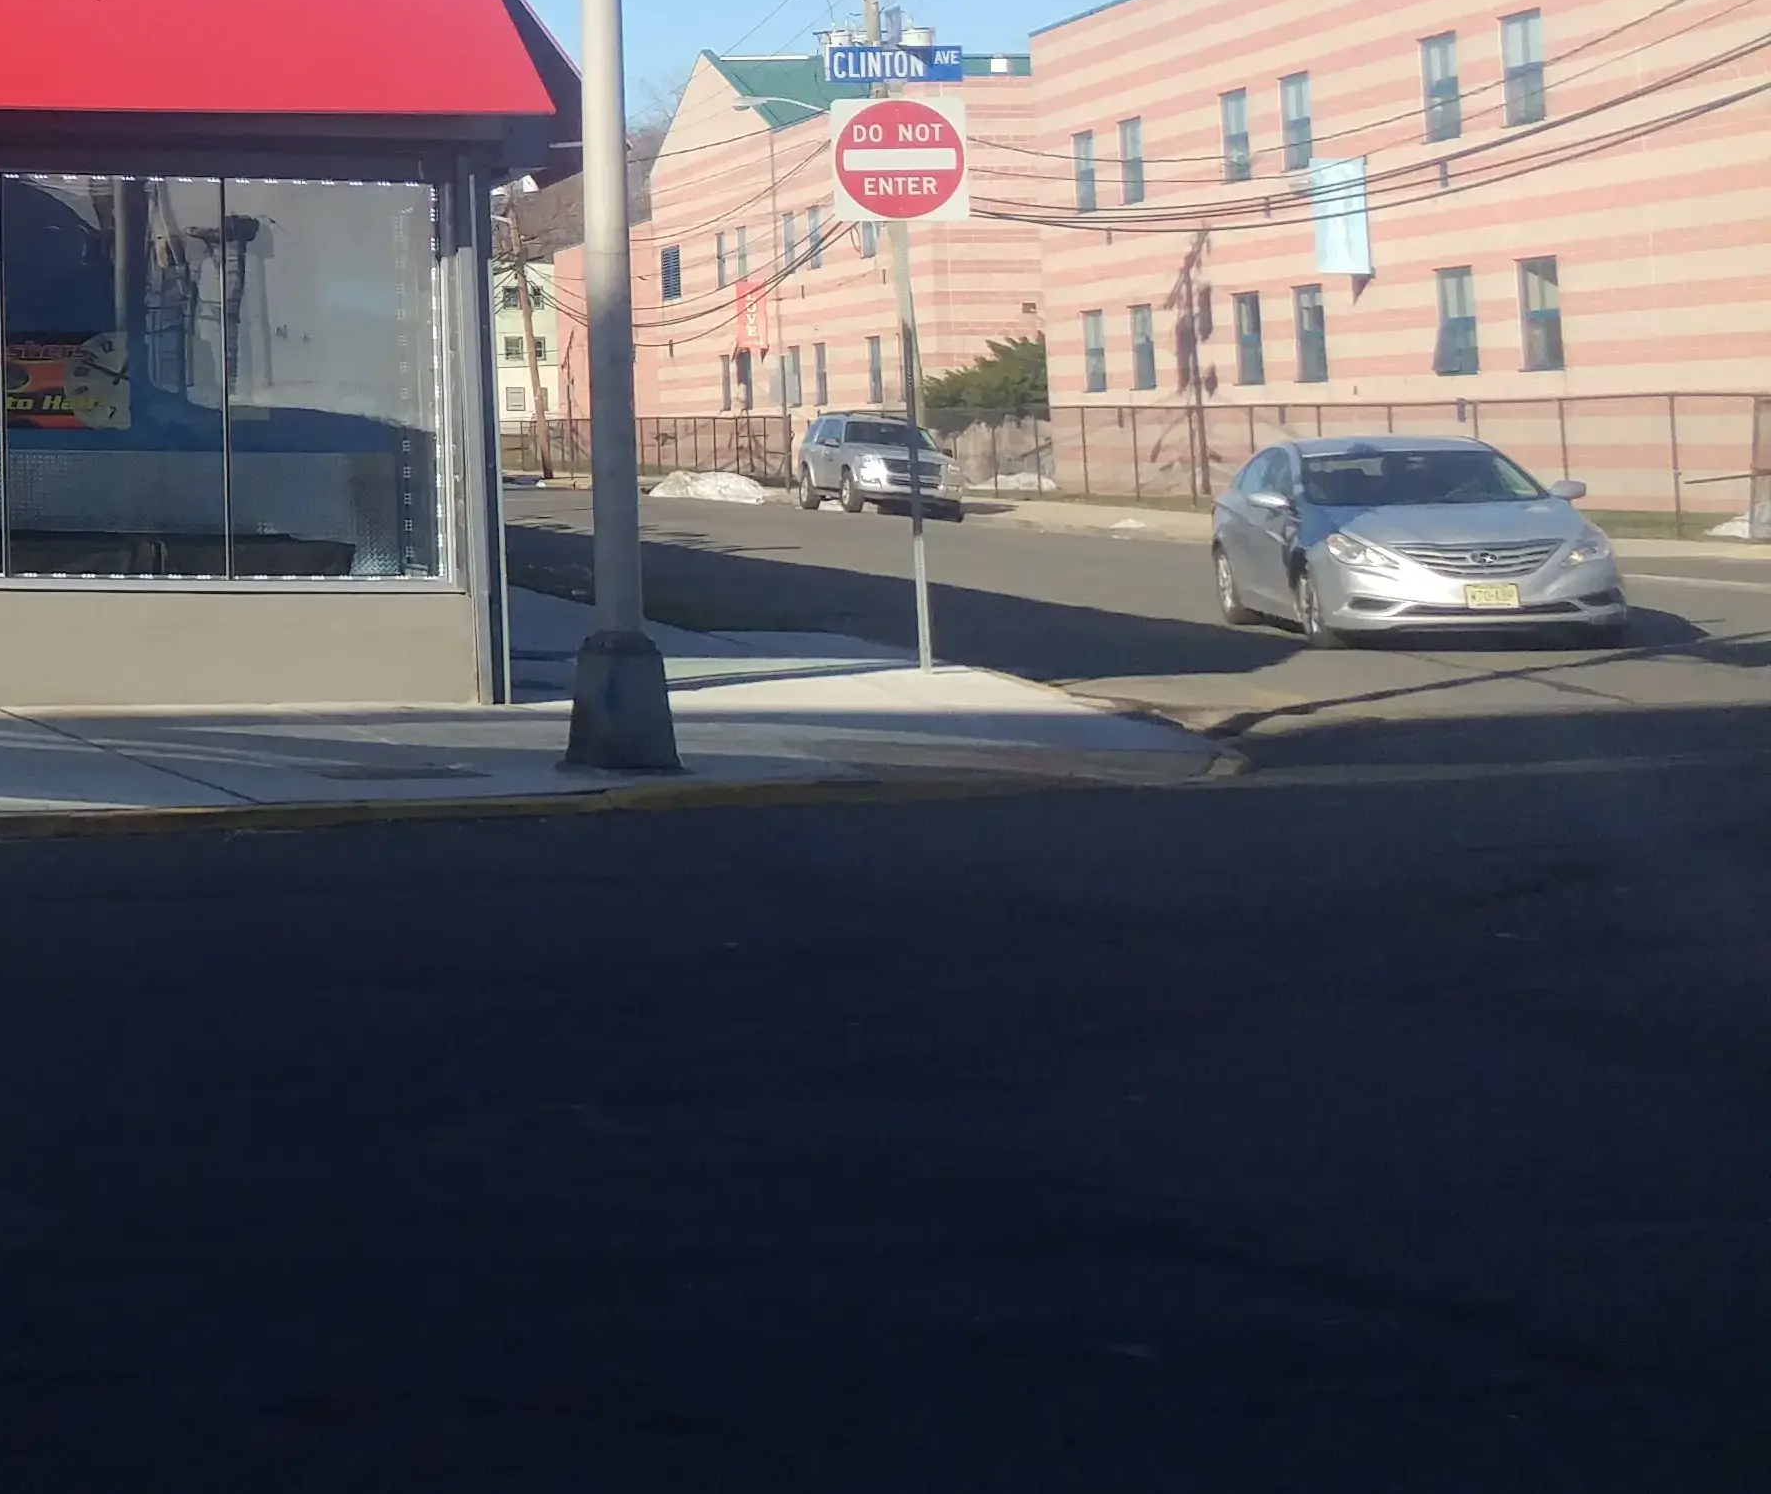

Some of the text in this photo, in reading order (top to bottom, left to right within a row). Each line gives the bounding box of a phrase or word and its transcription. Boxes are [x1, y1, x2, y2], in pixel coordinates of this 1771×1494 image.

[832, 50, 960, 79] CLINTON AVE
[852, 123, 943, 143] DO NOT
[864, 176, 938, 196] ENTER
[6, 396, 34, 410] to
